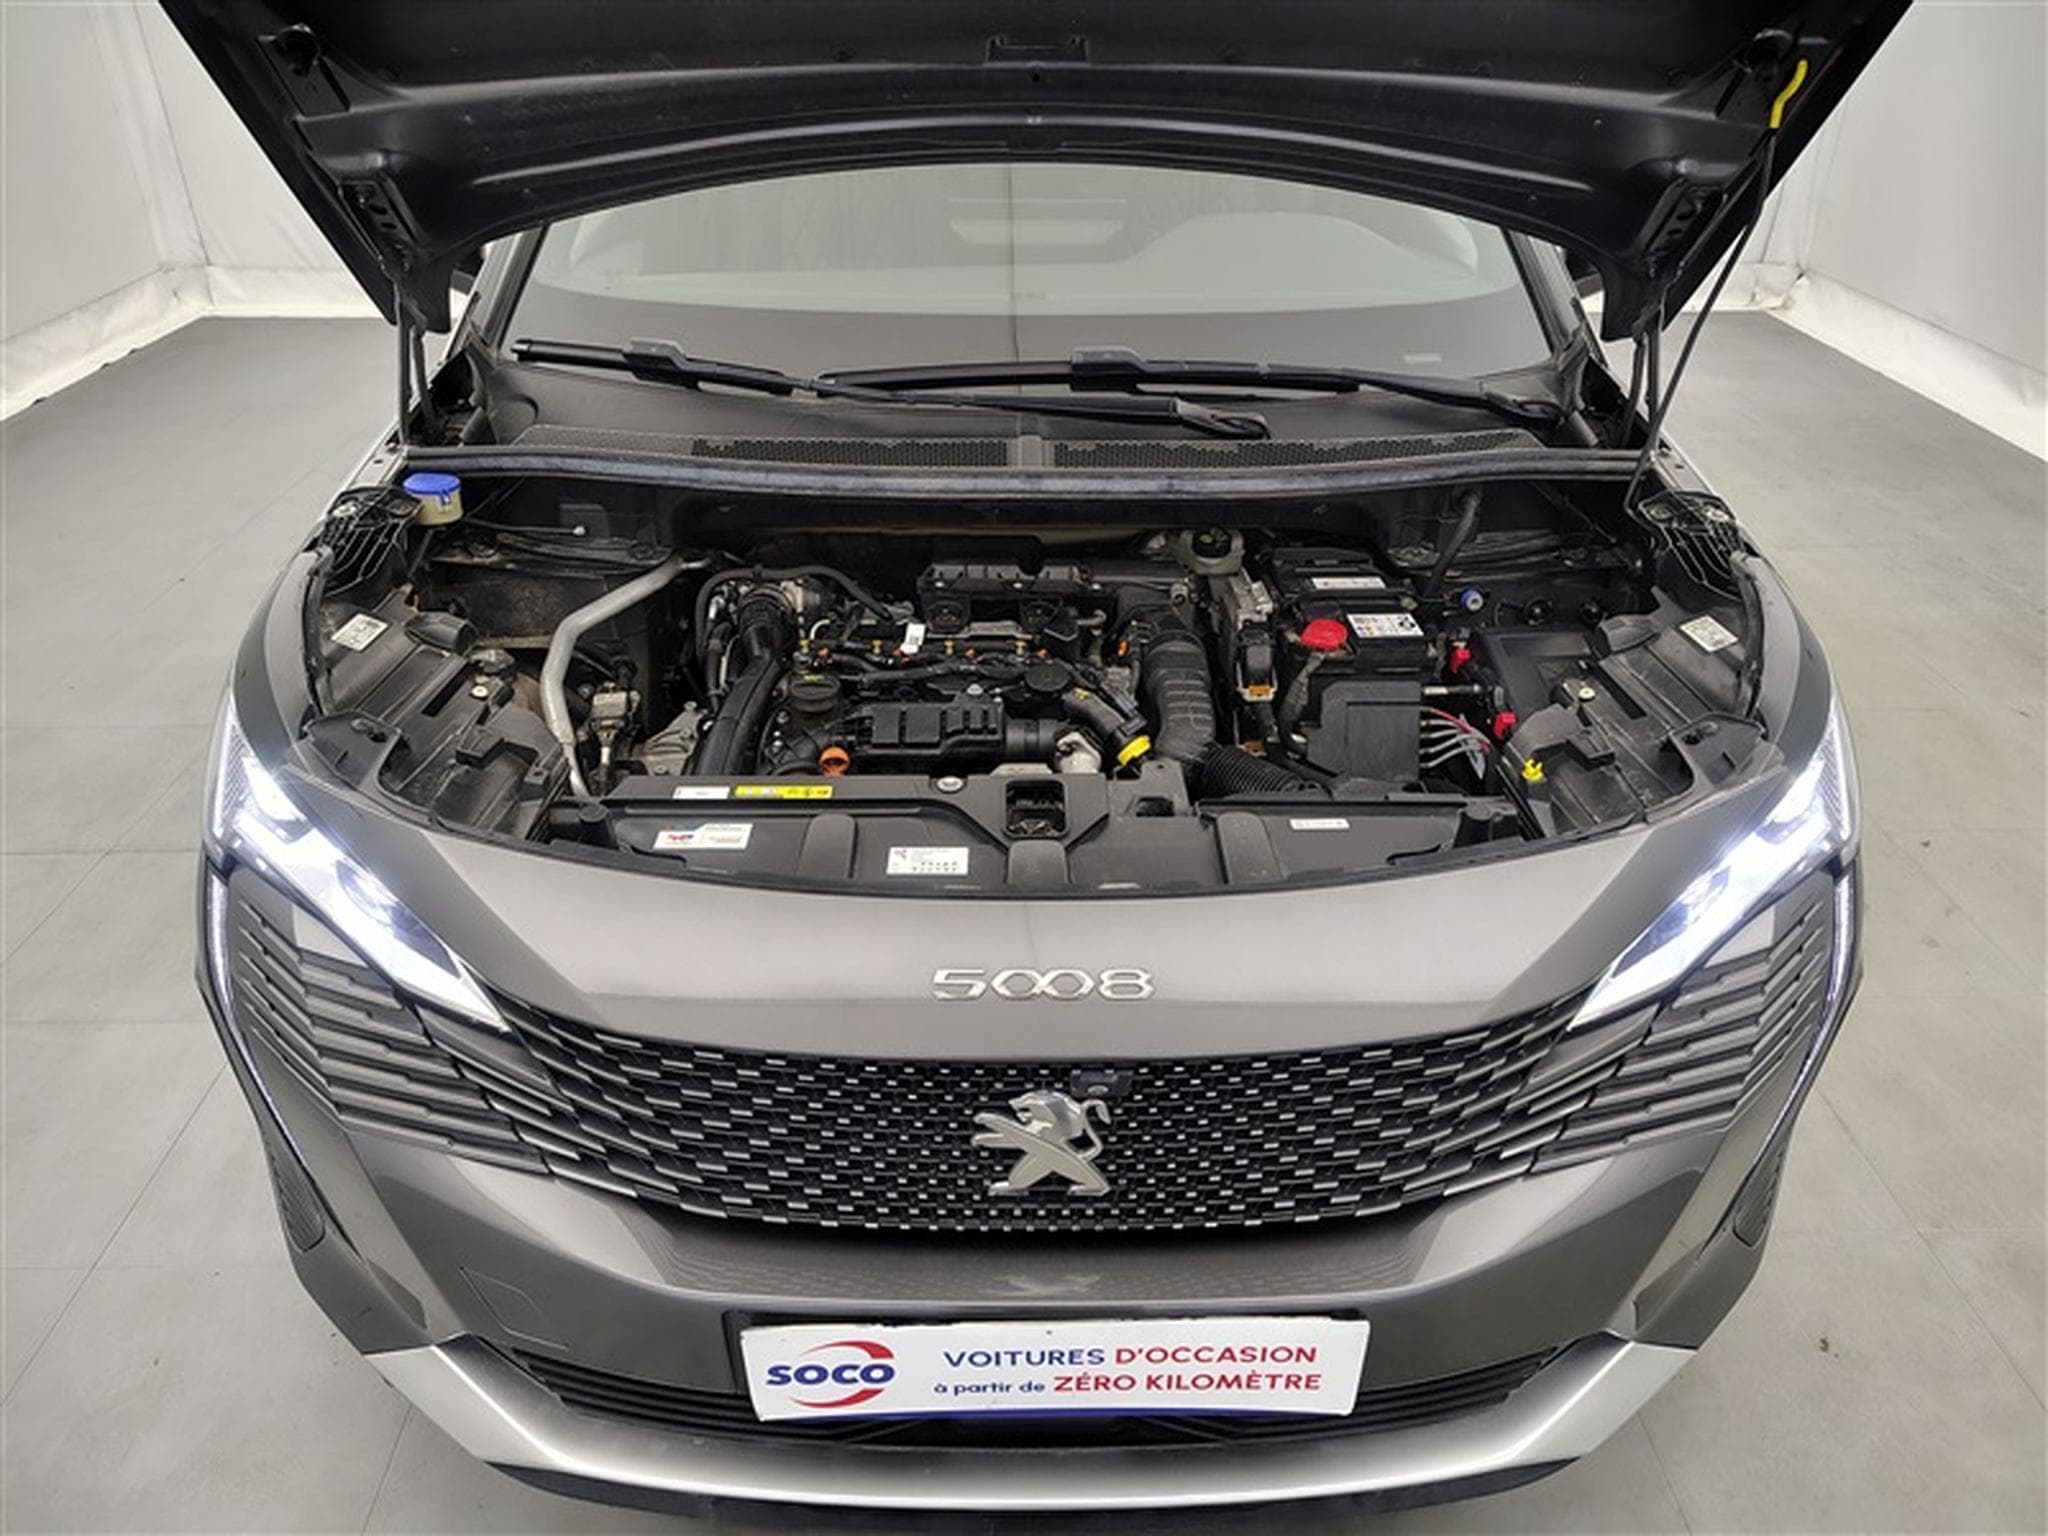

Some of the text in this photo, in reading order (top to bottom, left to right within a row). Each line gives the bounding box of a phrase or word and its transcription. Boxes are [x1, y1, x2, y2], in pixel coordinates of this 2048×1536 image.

[933, 968, 1155, 1000] 5008
[944, 1345, 1317, 1368] VOITURES D'OCCASION
[766, 1363, 895, 1386] SOCO
[934, 1368, 1323, 1397] à partir de ZÉRO KILOMÈTRE
